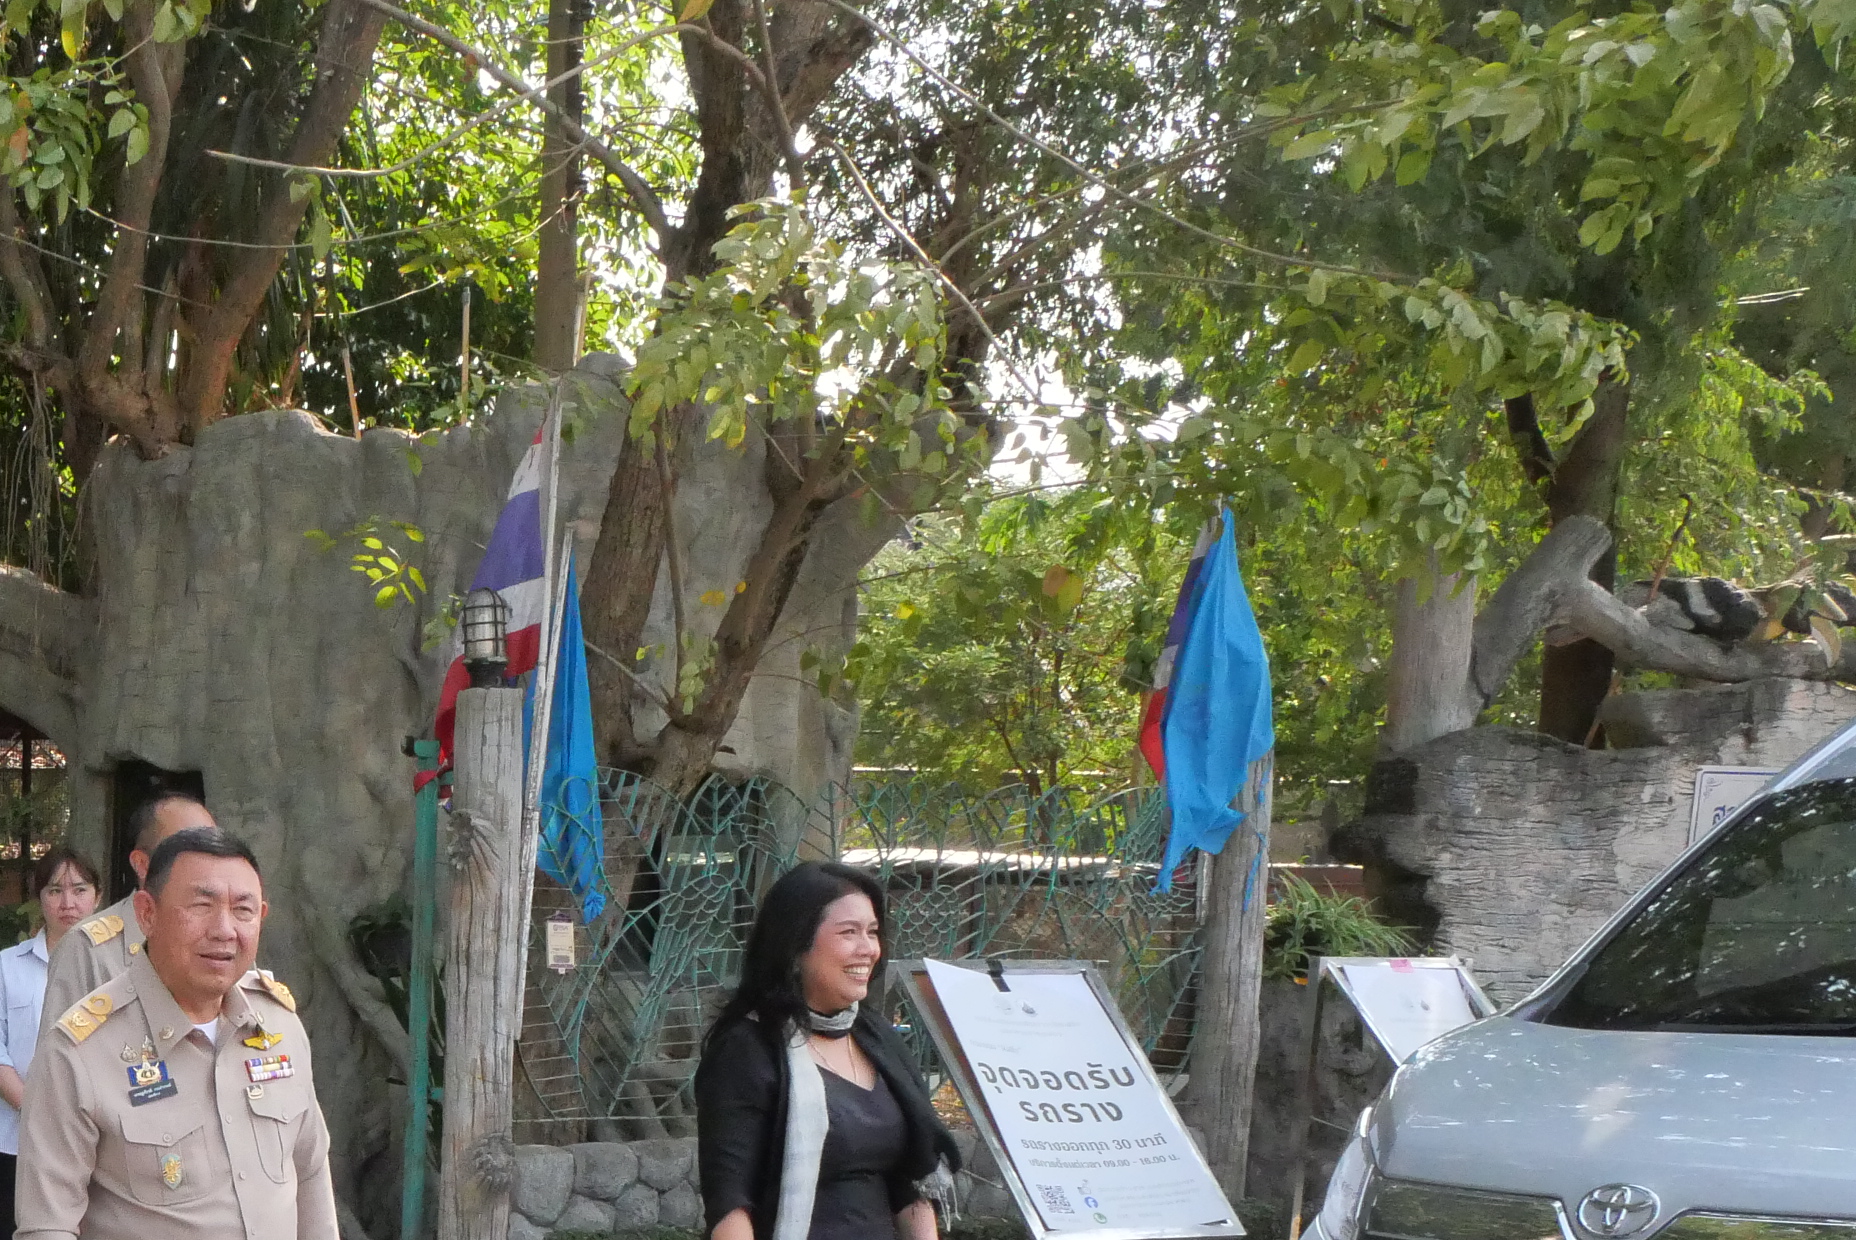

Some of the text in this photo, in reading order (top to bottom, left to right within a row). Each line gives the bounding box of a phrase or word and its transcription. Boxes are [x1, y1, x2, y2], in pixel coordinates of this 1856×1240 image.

[978, 1062, 1135, 1093] จุดจอดรับ
[1019, 1101, 1123, 1123] รถราง
[1021, 1133, 1167, 1155] รถรางออกทุก 30 นาที
